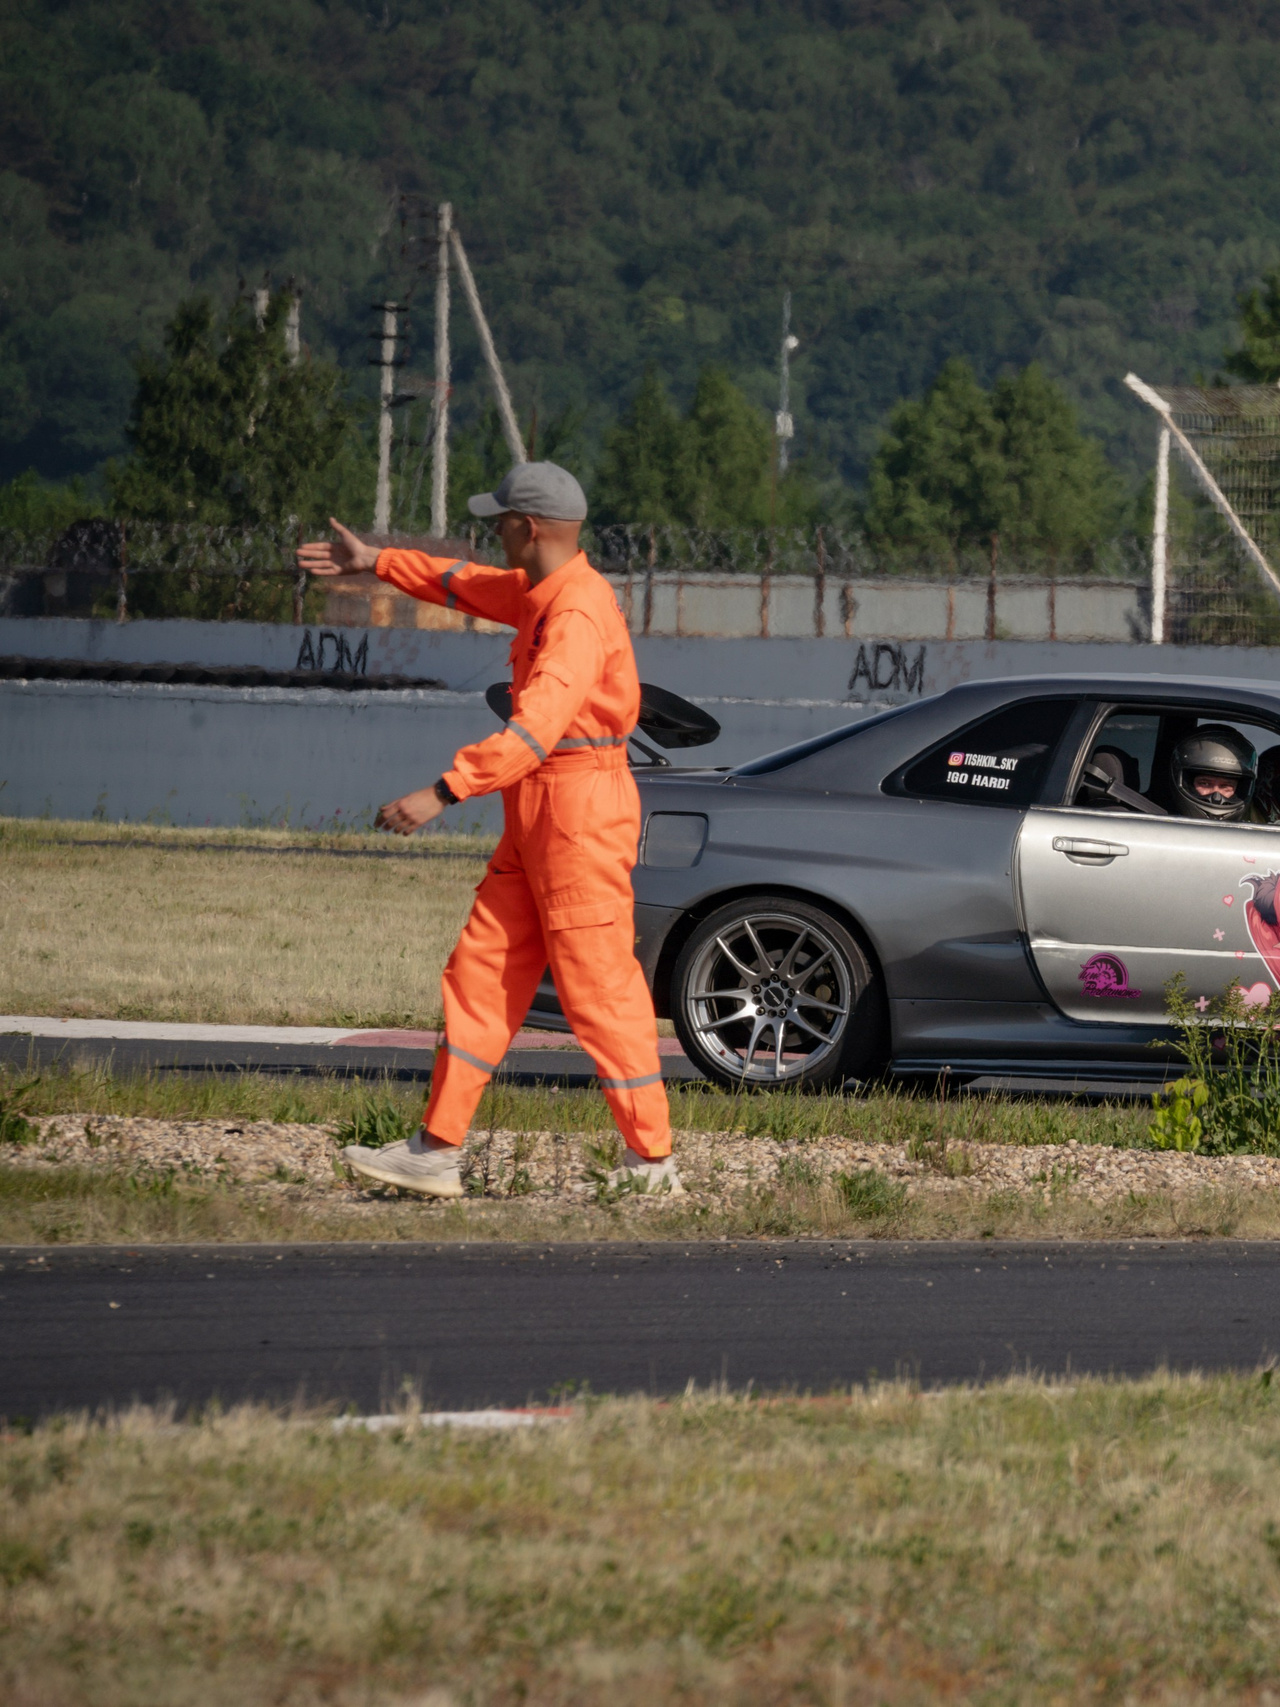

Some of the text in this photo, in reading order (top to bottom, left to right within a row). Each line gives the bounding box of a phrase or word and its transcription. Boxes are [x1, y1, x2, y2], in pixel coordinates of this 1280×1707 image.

[297, 629, 368, 674] ADM
[848, 643, 926, 695] ADM
[971, 774, 1010, 790] HARD!
